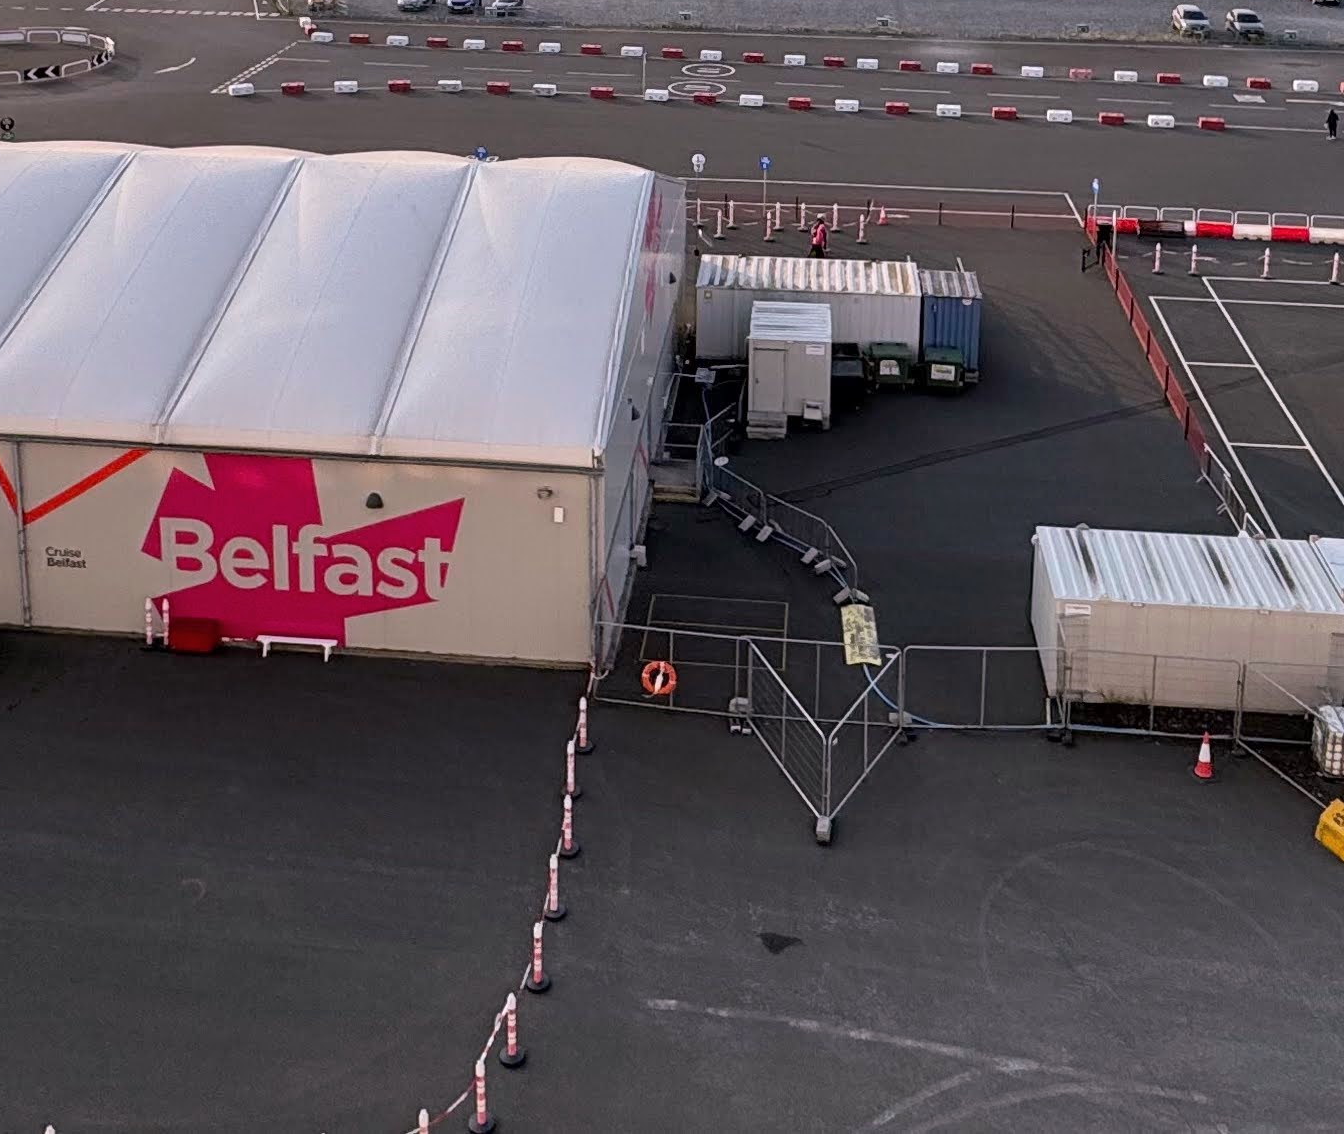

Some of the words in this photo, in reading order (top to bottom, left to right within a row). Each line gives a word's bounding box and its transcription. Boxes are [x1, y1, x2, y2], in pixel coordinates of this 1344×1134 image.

[45, 546, 82, 558] Cruise
[47, 557, 87, 568] Belfast
[159, 516, 454, 602] Belfast
